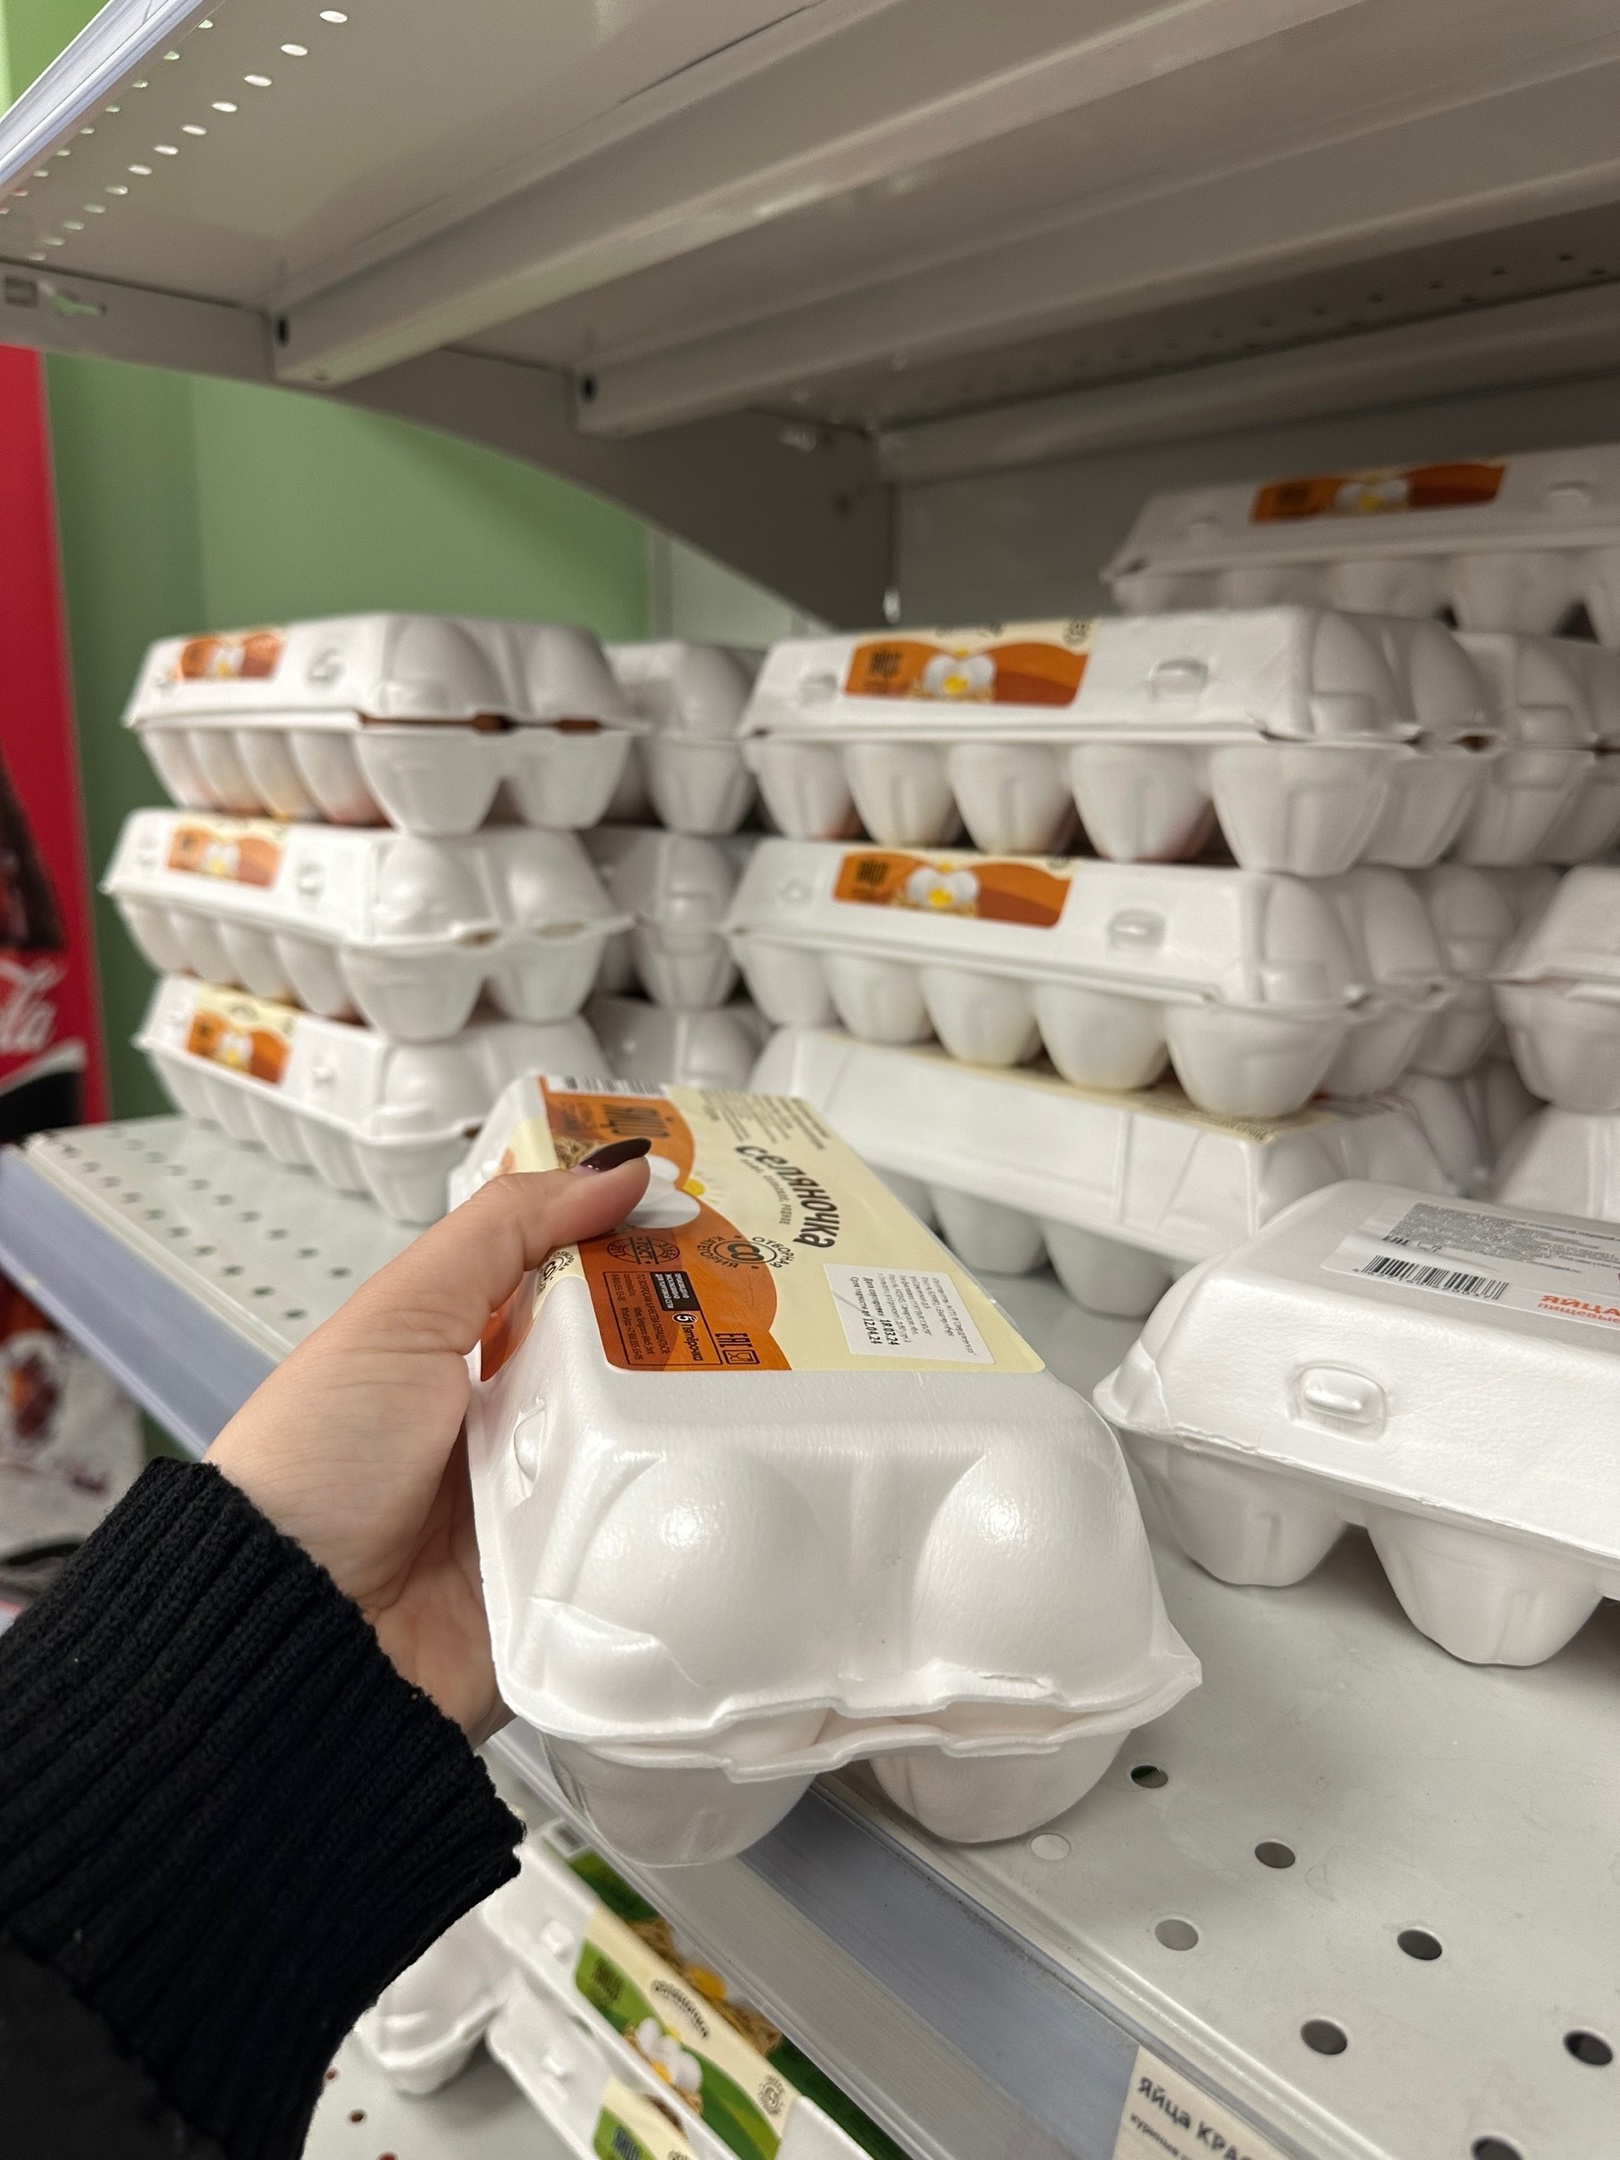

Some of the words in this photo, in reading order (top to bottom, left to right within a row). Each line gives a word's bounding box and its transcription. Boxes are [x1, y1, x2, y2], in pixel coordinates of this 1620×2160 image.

[635, 1240, 653, 1260] ГОСТ
[696, 1235, 739, 1269] КАТЕГОРИЯ
[752, 1236, 795, 1268] ОТБОРНАЯ
[676, 1313, 696, 1322] 5
[1540, 1295, 1620, 1317] ЯЙЦА
[681, 1324, 703, 1361] Пятёрочка
[863, 1318, 882, 1345] 12.04.24
[1138, 2075, 1191, 2130] Яйца
